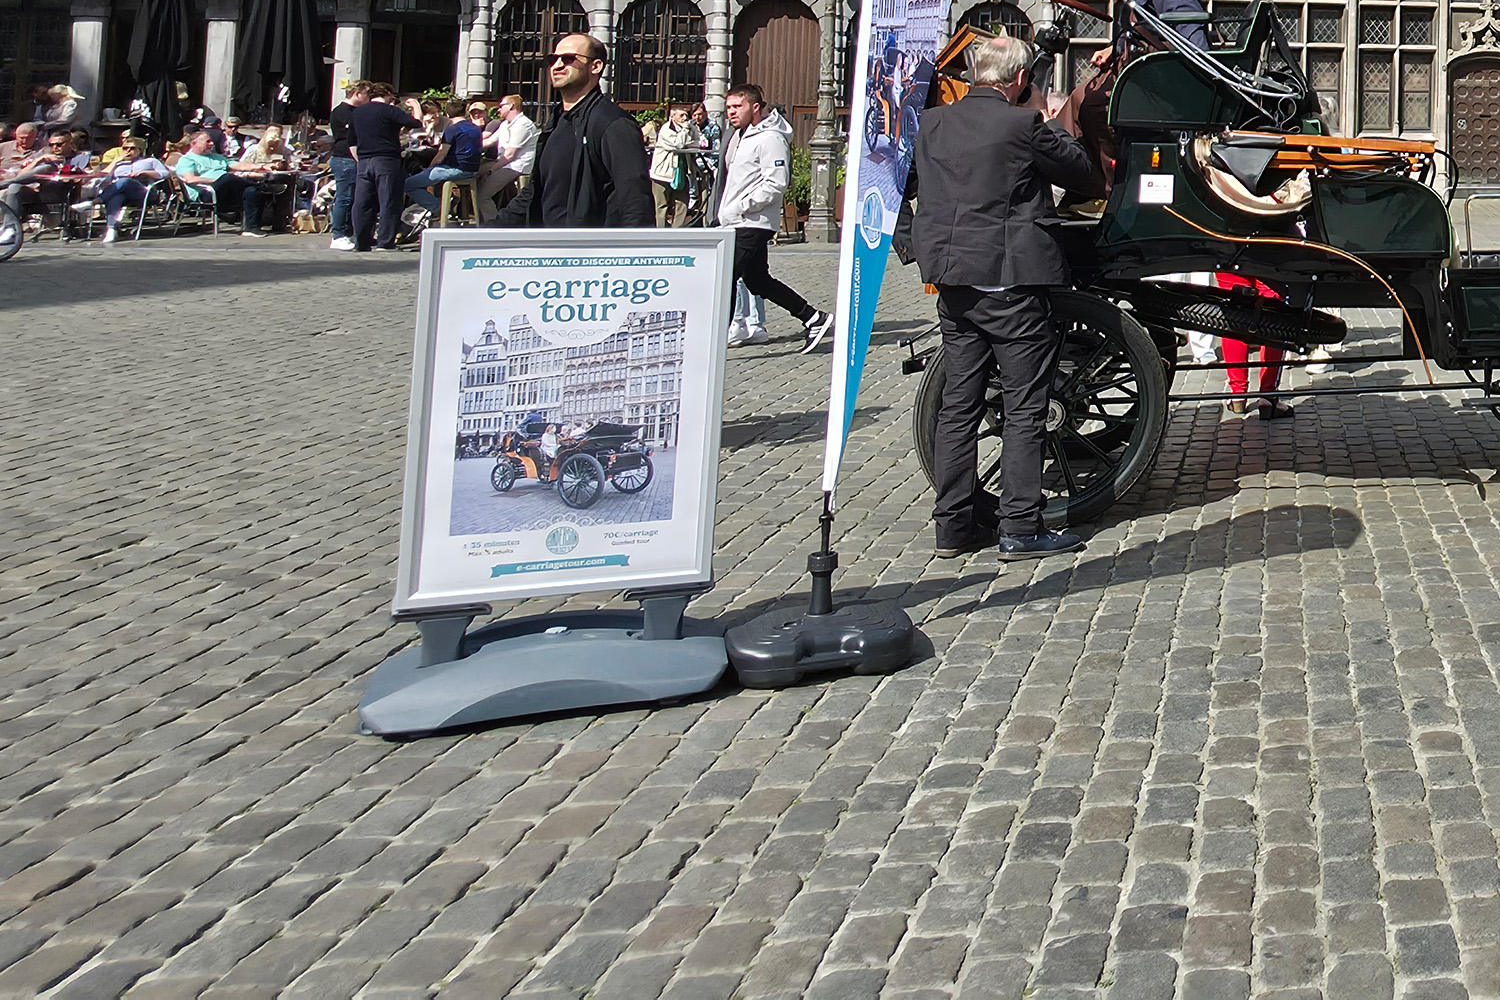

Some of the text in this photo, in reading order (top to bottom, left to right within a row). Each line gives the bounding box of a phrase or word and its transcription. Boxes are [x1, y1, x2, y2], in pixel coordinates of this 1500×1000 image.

[474, 257, 685, 267] AN AMAZING WAY TO DISCOVER ANTWERP!
[487, 272, 670, 304] e-carriage
[540, 300, 618, 323] tour
[516, 557, 606, 571] e-carriagetour.com
